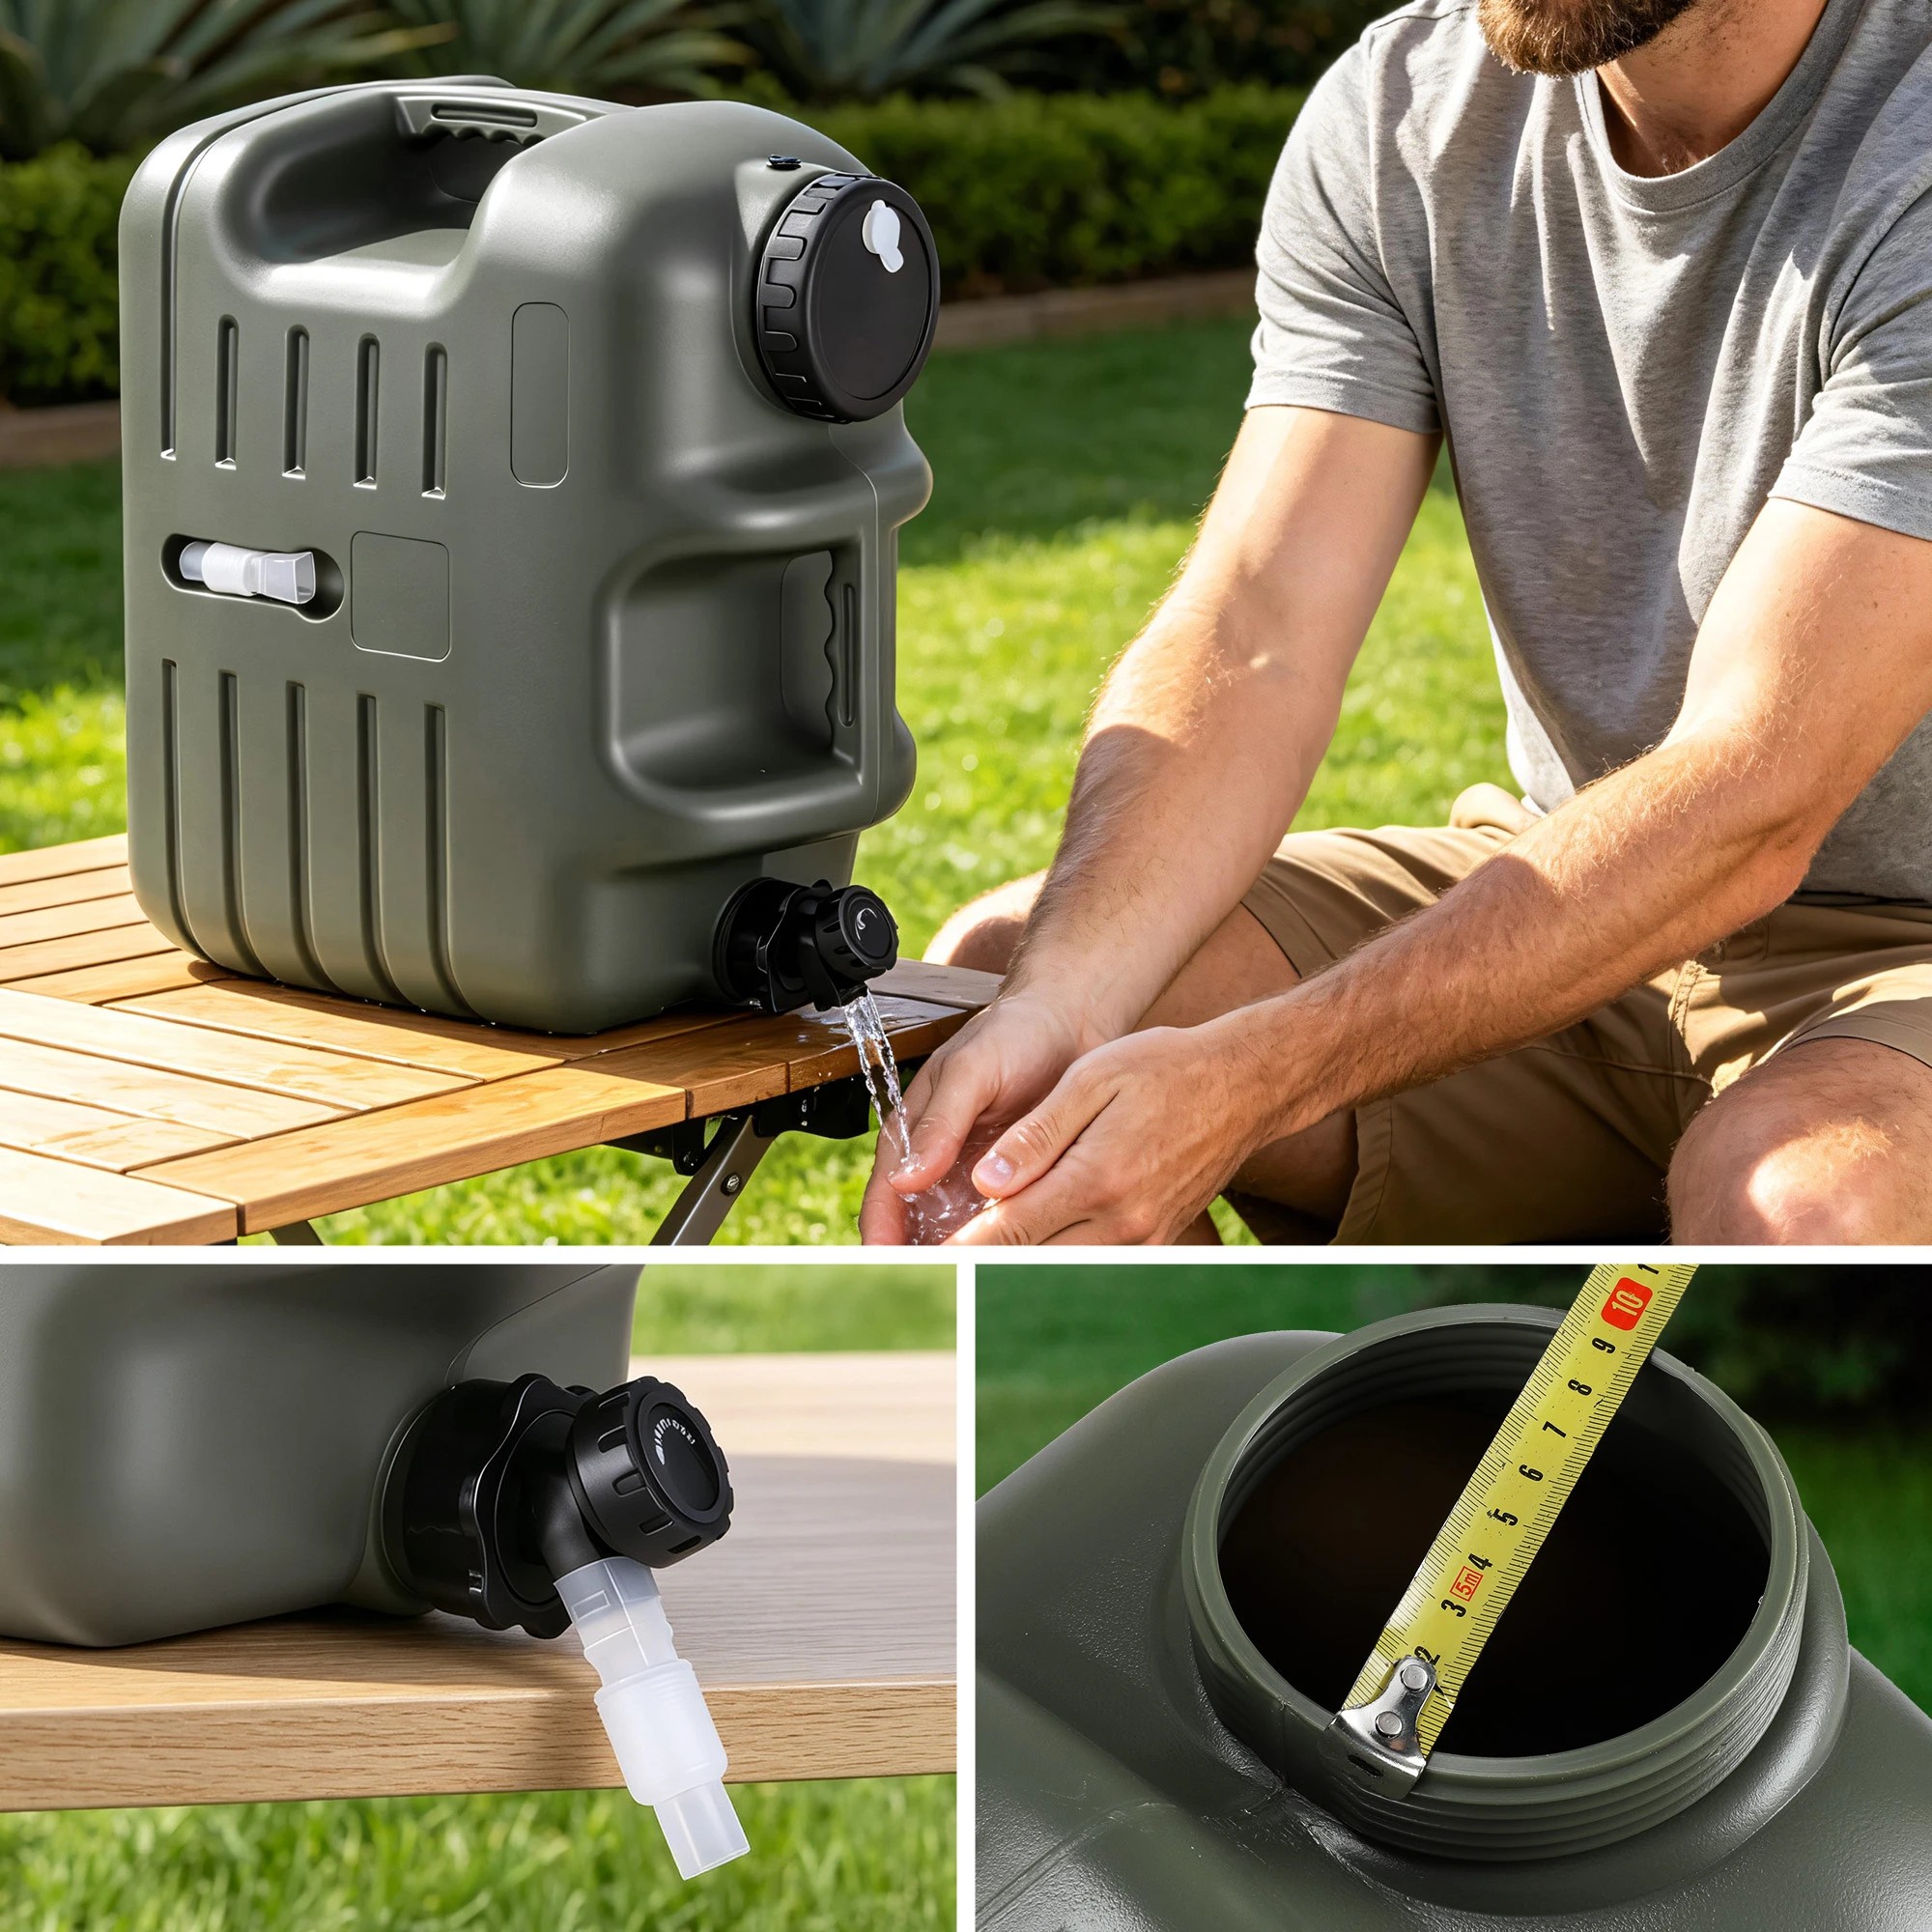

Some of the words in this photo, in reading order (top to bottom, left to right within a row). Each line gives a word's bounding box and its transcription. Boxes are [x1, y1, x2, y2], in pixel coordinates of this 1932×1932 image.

[1414, 1646, 1440, 1665] 2
[1441, 1600, 1466, 1617] 3
[1456, 1573, 1480, 1596] 5m
[1468, 1553, 1492, 1570] 4
[1493, 1509, 1518, 1525] 5
[1520, 1464, 1543, 1481] 6
[1543, 1421, 1566, 1437] 7
[1568, 1379, 1592, 1395] 8
[1592, 1338, 1615, 1353] 9
[1611, 1290, 1644, 1317] 10
